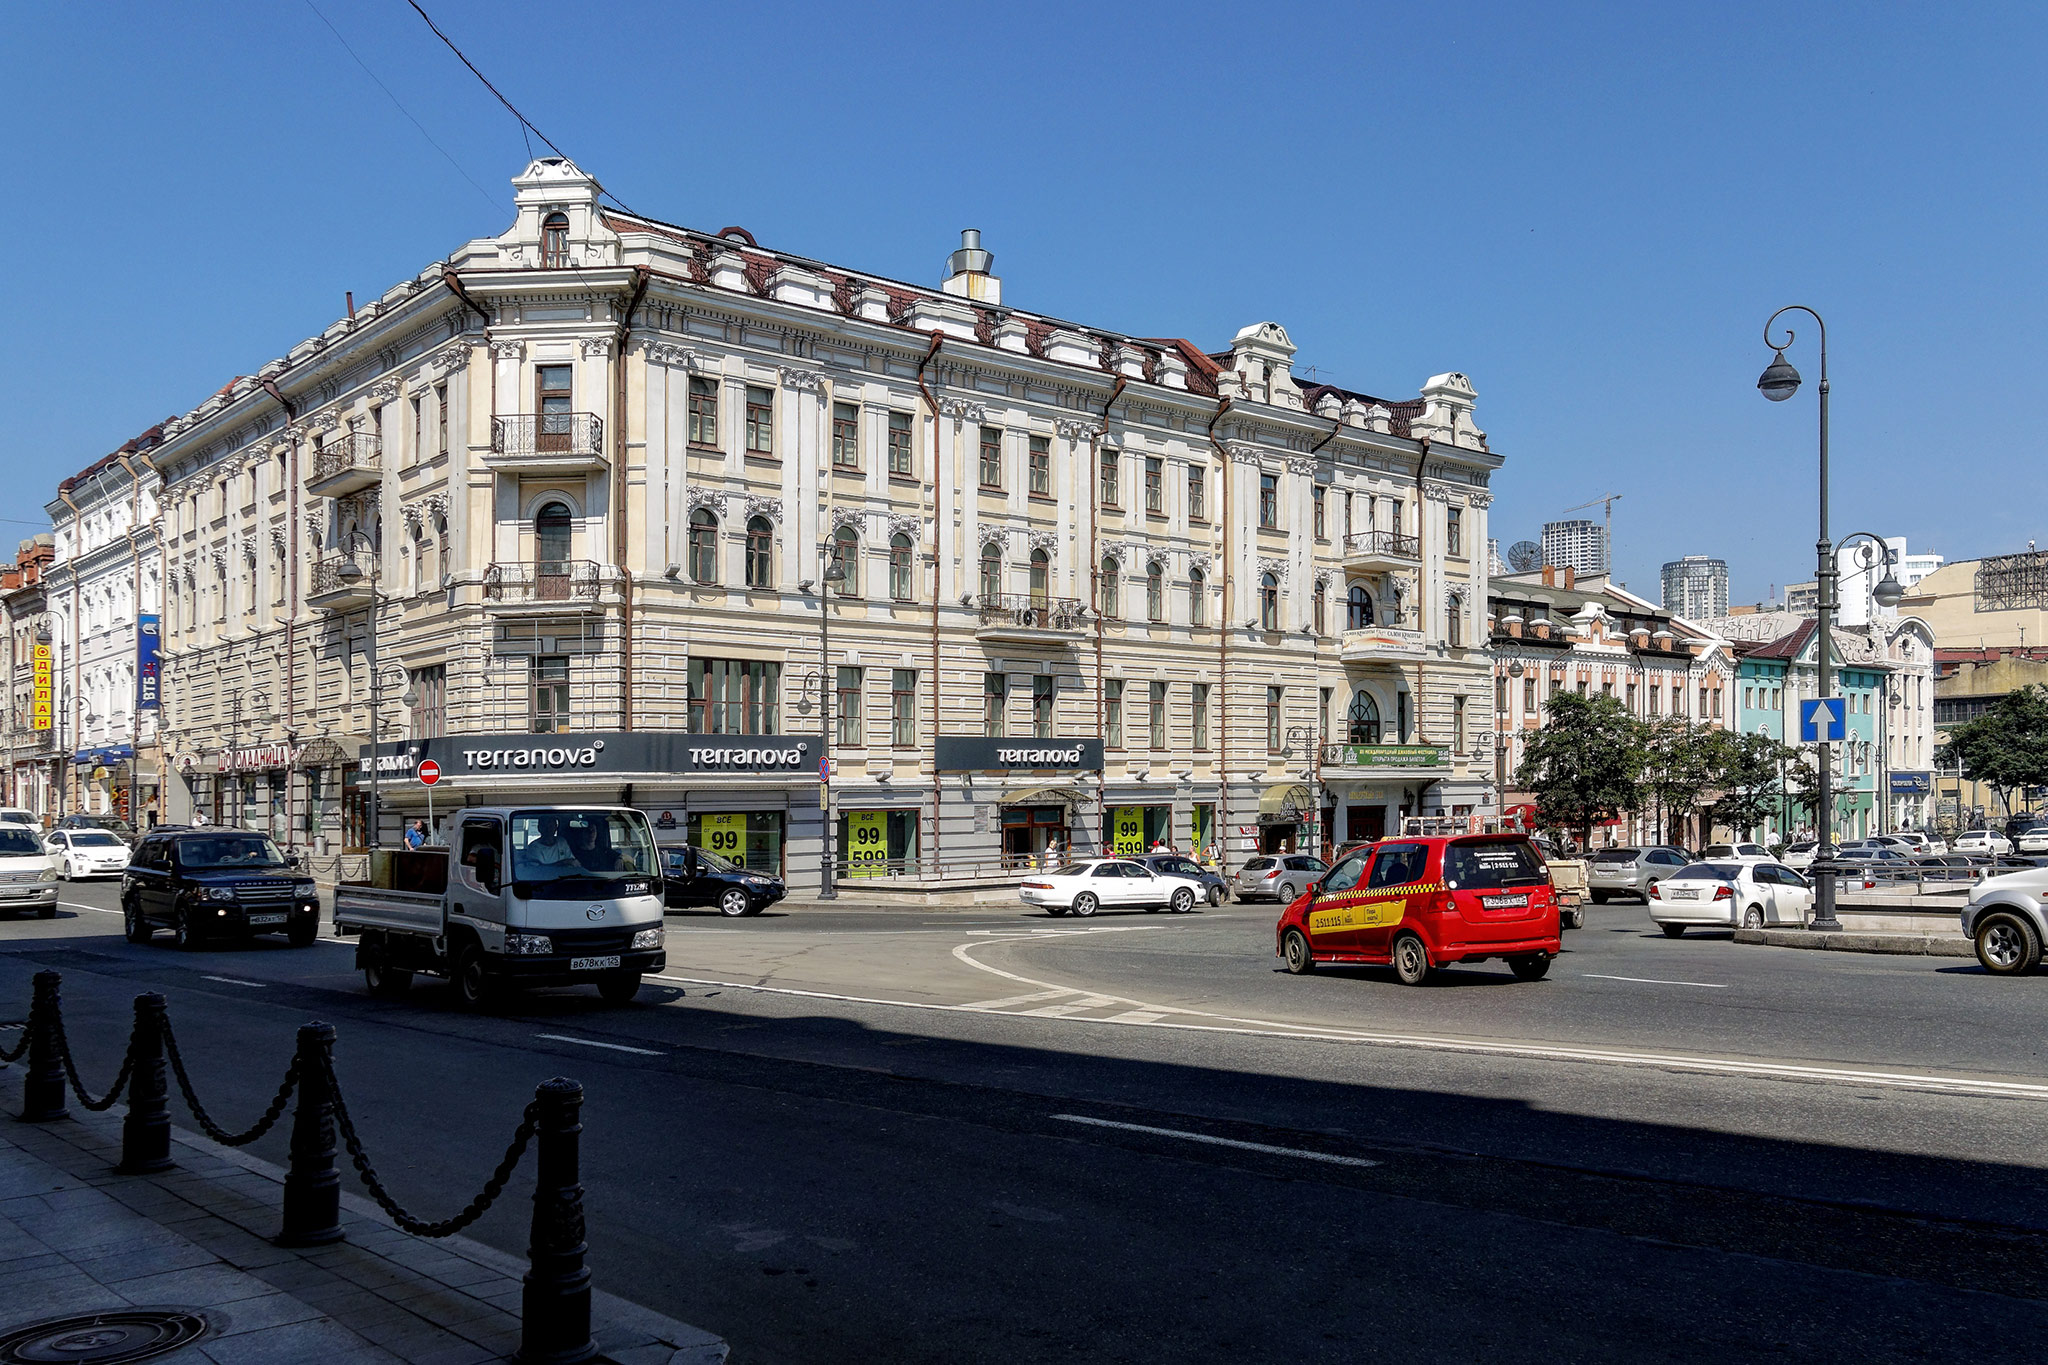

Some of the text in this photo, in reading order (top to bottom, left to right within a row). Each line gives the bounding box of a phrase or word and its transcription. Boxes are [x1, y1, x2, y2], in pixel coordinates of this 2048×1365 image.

[143, 662, 156, 701] ВТБ24
[217, 746, 286, 772] ШООЛАДНИЦА
[463, 747, 596, 767] Terranova
[689, 748, 801, 764] Terranova
[997, 749, 1080, 763] Terranova
[716, 815, 732, 824] ВСЕ
[861, 813, 875, 821] ВСЕ
[857, 827, 880, 845] 99
[1120, 821, 1138, 837] 99
[711, 830, 738, 850] 99
[1117, 841, 1143, 855] 599
[852, 850, 886, 868] 599
[573, 957, 619, 969] В678КК 125
